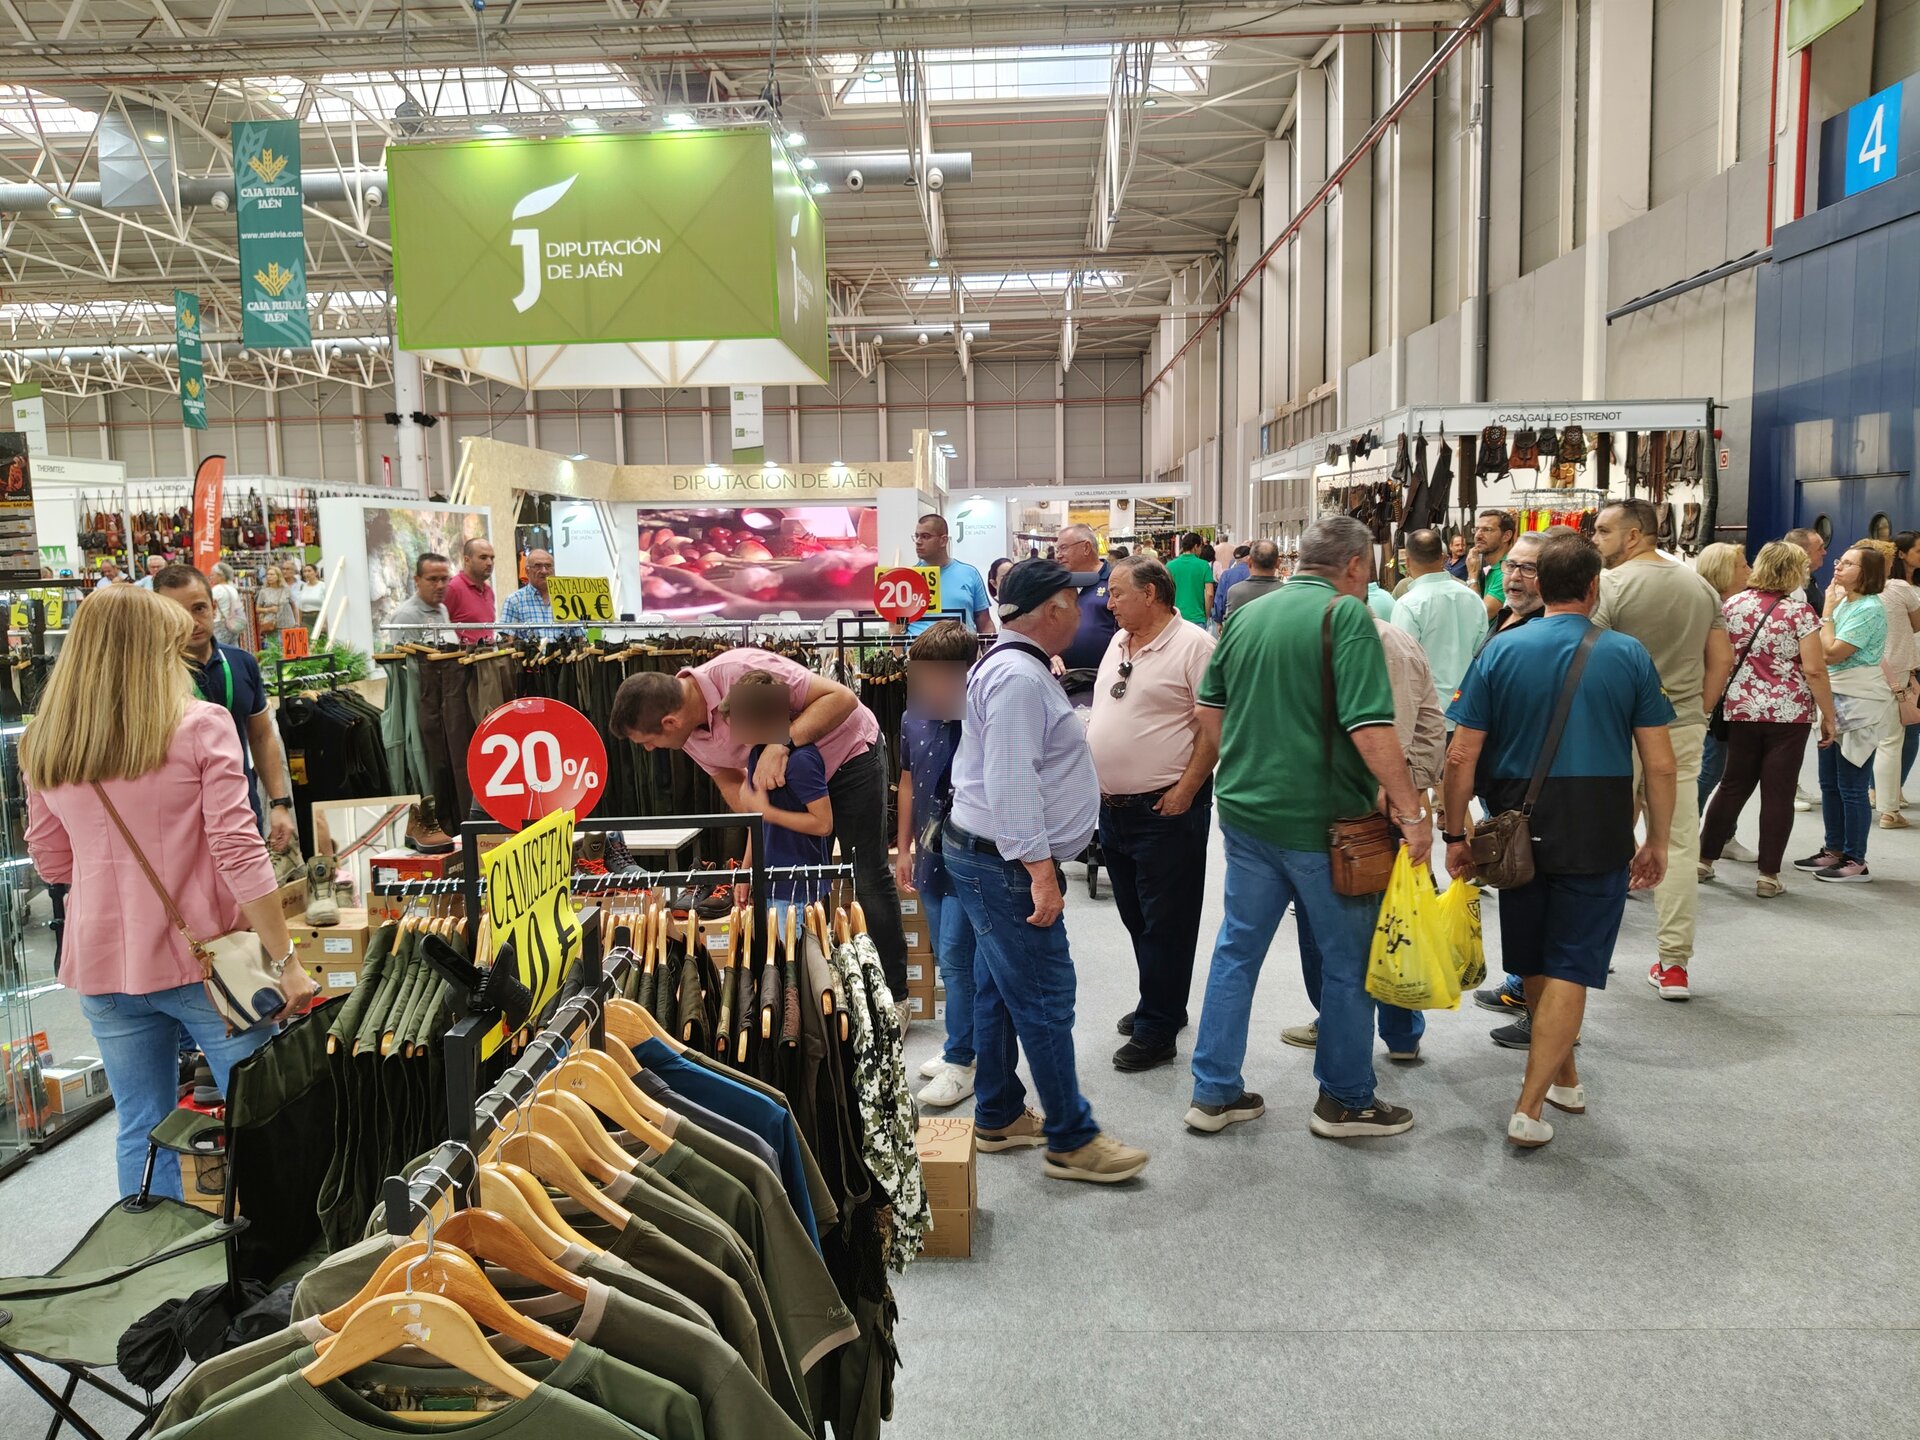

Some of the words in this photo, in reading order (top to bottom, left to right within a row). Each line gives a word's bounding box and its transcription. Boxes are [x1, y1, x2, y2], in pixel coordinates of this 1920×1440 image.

[1859, 103, 1887, 174] 4
[240, 187, 264, 198] CAJA
[265, 186, 299, 197] RURAL
[257, 198, 282, 210] JAÉN
[241, 231, 304, 240] www.ruralvia.com
[545, 236, 661, 258] DIPUTACIÓN
[547, 264, 573, 280] DE
[576, 260, 623, 279] JAÉN
[246, 301, 269, 312] CAJA
[271, 300, 305, 311] RURAL
[263, 311, 289, 323] JAÉN
[1498, 413, 1526, 423] CASA
[1570, 411, 1622, 421] ESTRENOT
[801, 473, 828, 489] DE
[832, 469, 883, 488] JAÉN
[547, 578, 610, 595] PANTALONES
[879, 580, 927, 609] 20%
[553, 594, 588, 620] 30
[593, 594, 613, 620] €
[480, 730, 599, 798] 20%
[489, 819, 574, 931] CAMISETAS
